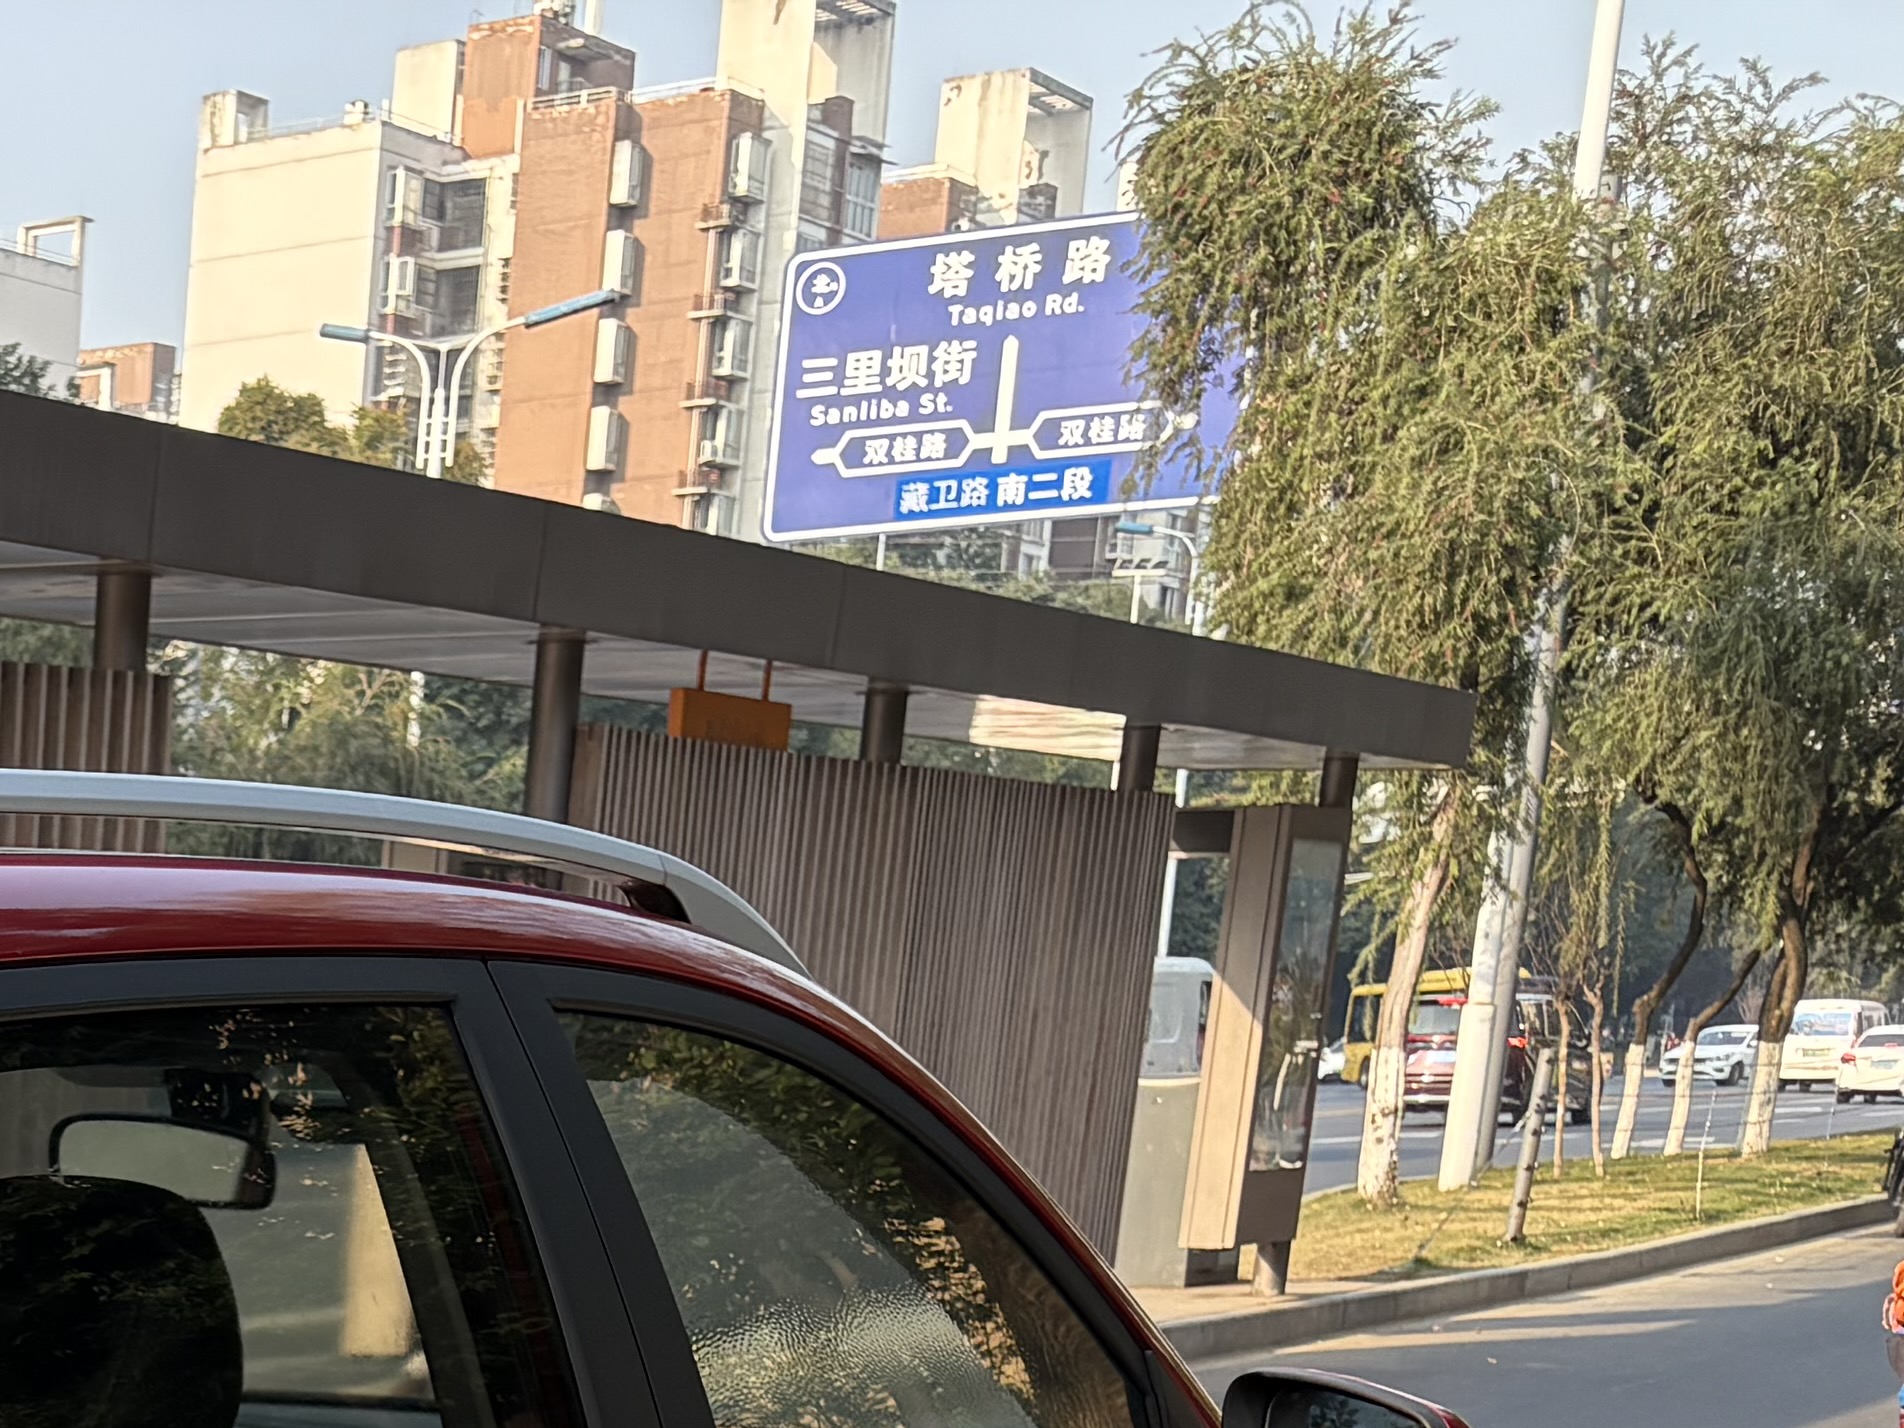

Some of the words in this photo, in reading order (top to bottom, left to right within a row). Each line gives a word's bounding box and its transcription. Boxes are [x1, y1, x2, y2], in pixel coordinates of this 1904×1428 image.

[927, 236, 1111, 298] 塔桥路
[948, 299, 1037, 326] Taqiao
[1045, 291, 1085, 316] Rd.
[795, 339, 978, 399] 三里坝街
[809, 398, 910, 426] Sanliba
[919, 392, 953, 415] St.
[1058, 413, 1147, 446] 双桂路
[863, 432, 946, 464] 双桂路
